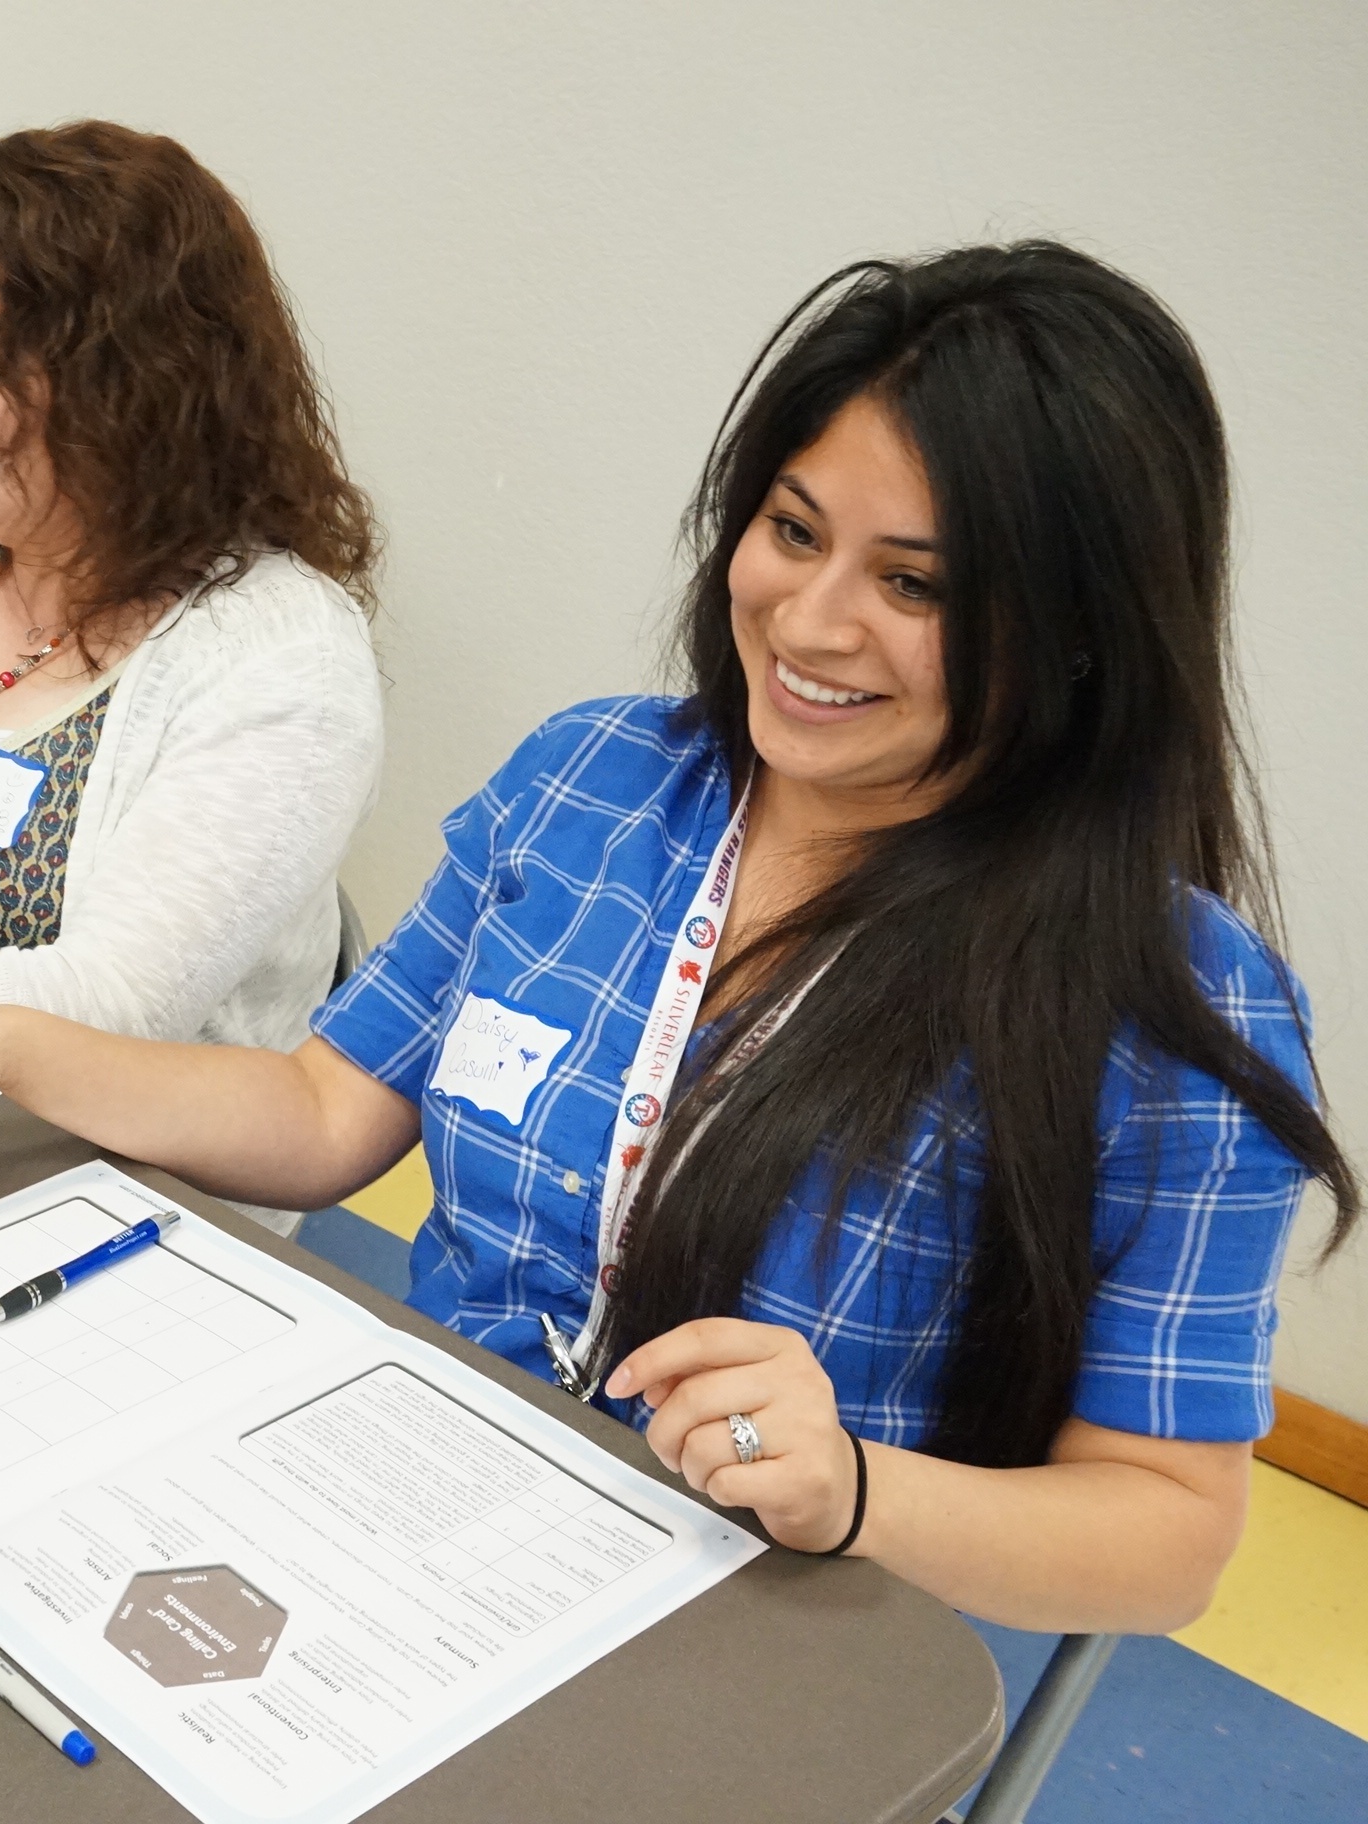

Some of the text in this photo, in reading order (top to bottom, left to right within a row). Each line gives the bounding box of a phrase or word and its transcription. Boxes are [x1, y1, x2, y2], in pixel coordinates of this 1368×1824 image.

[708, 834, 741, 908] RANGERS
[462, 997, 518, 1052] Daisy
[648, 987, 690, 1081] SILVERLEAF
[271, 1458, 285, 1466] gift
[283, 1465, 295, 1475] this
[295, 1474, 309, 1485] with
[325, 1497, 340, 1508] love
[339, 1506, 356, 1519] most
[359, 1521, 378, 1535] What
[147, 1541, 173, 1562] Social
[84, 1557, 111, 1581] Artistic
[172, 1575, 207, 1584] Feelings
[24, 1582, 72, 1624] Investigative
[240, 1587, 263, 1607] People
[421, 1563, 520, 1631] Gift/Environment Priority
[164, 1594, 237, 1653] Environments
[179, 1627, 217, 1659] Calling
[434, 1636, 479, 1669] Summary
[130, 1649, 152, 1668] Things
[288, 1650, 342, 1693] Enterprising
[178, 1712, 215, 1744] Realistic
[248, 1693, 308, 1740] Conventional
